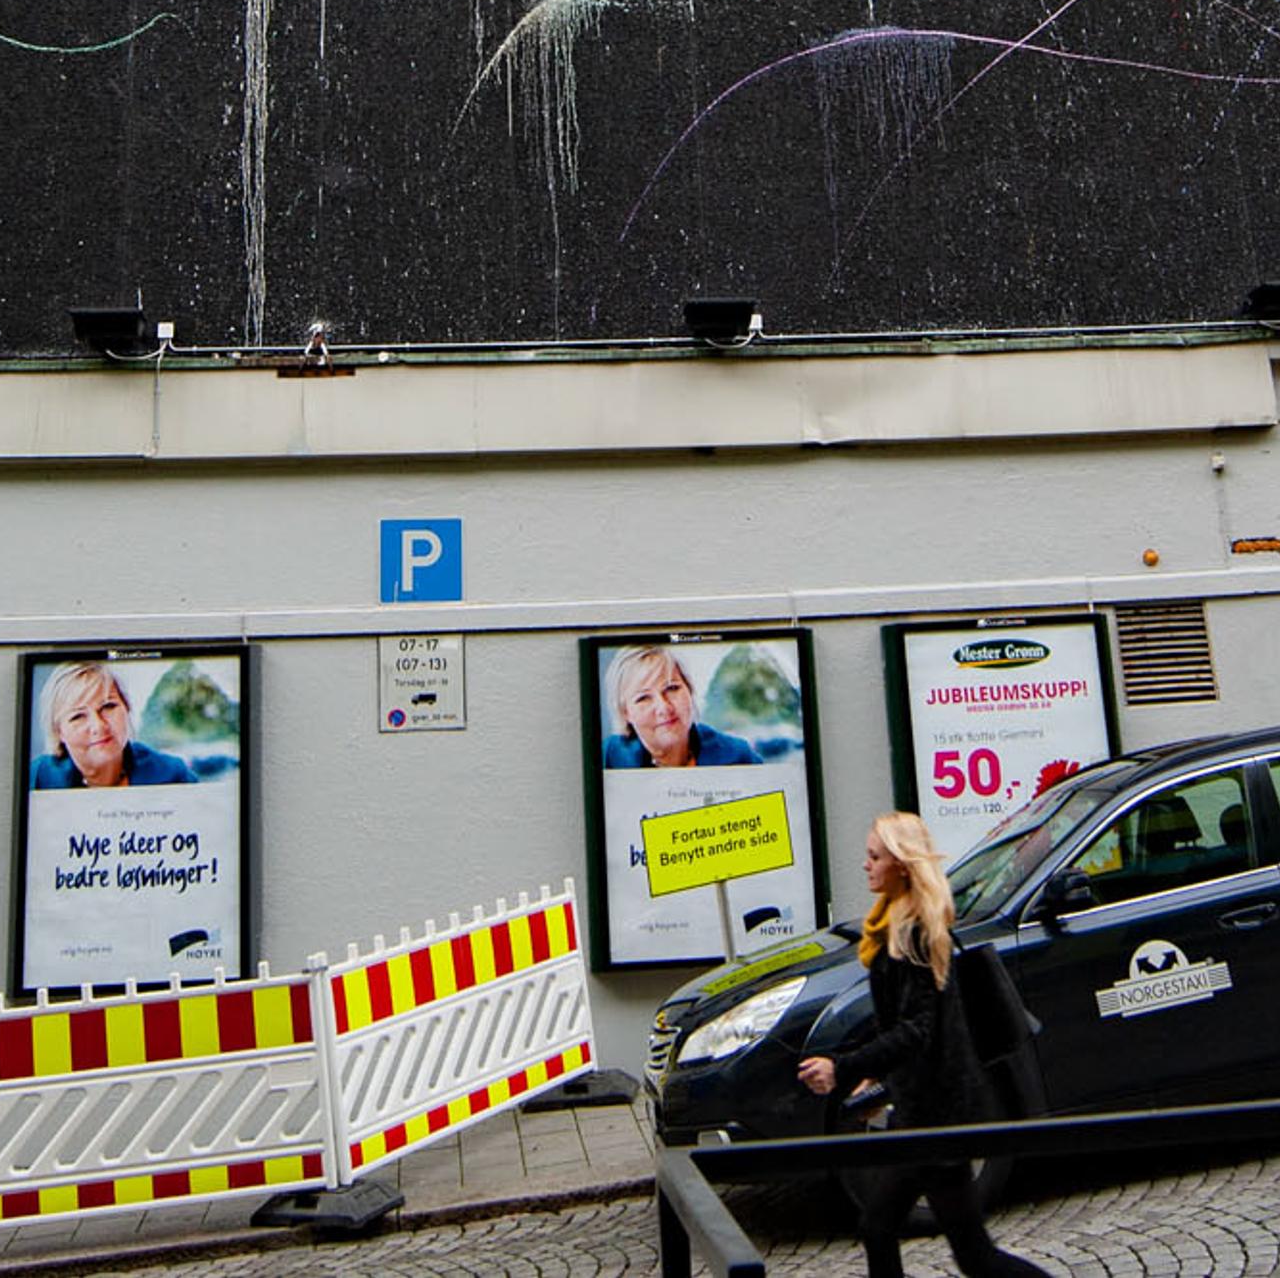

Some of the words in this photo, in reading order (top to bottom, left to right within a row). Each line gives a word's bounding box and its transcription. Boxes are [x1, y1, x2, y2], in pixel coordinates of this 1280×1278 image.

[401, 529, 443, 592] P
[960, 645, 1002, 661] Mester
[1005, 643, 1045, 659] Grønn
[926, 680, 1088, 705] JUBILEUMSKUPP!
[934, 732, 947, 744] 15
[671, 825, 716, 844] Fortau
[719, 815, 762, 836] stengt
[69, 833, 111, 867] Nye
[119, 831, 168, 856] ideer
[172, 832, 199, 860] og
[659, 844, 705, 867] Benytt
[707, 837, 747, 856] andre
[750, 831, 778, 848] side
[55, 865, 109, 890] bedre
[1120, 971, 1209, 1006] NORGESTAXI
